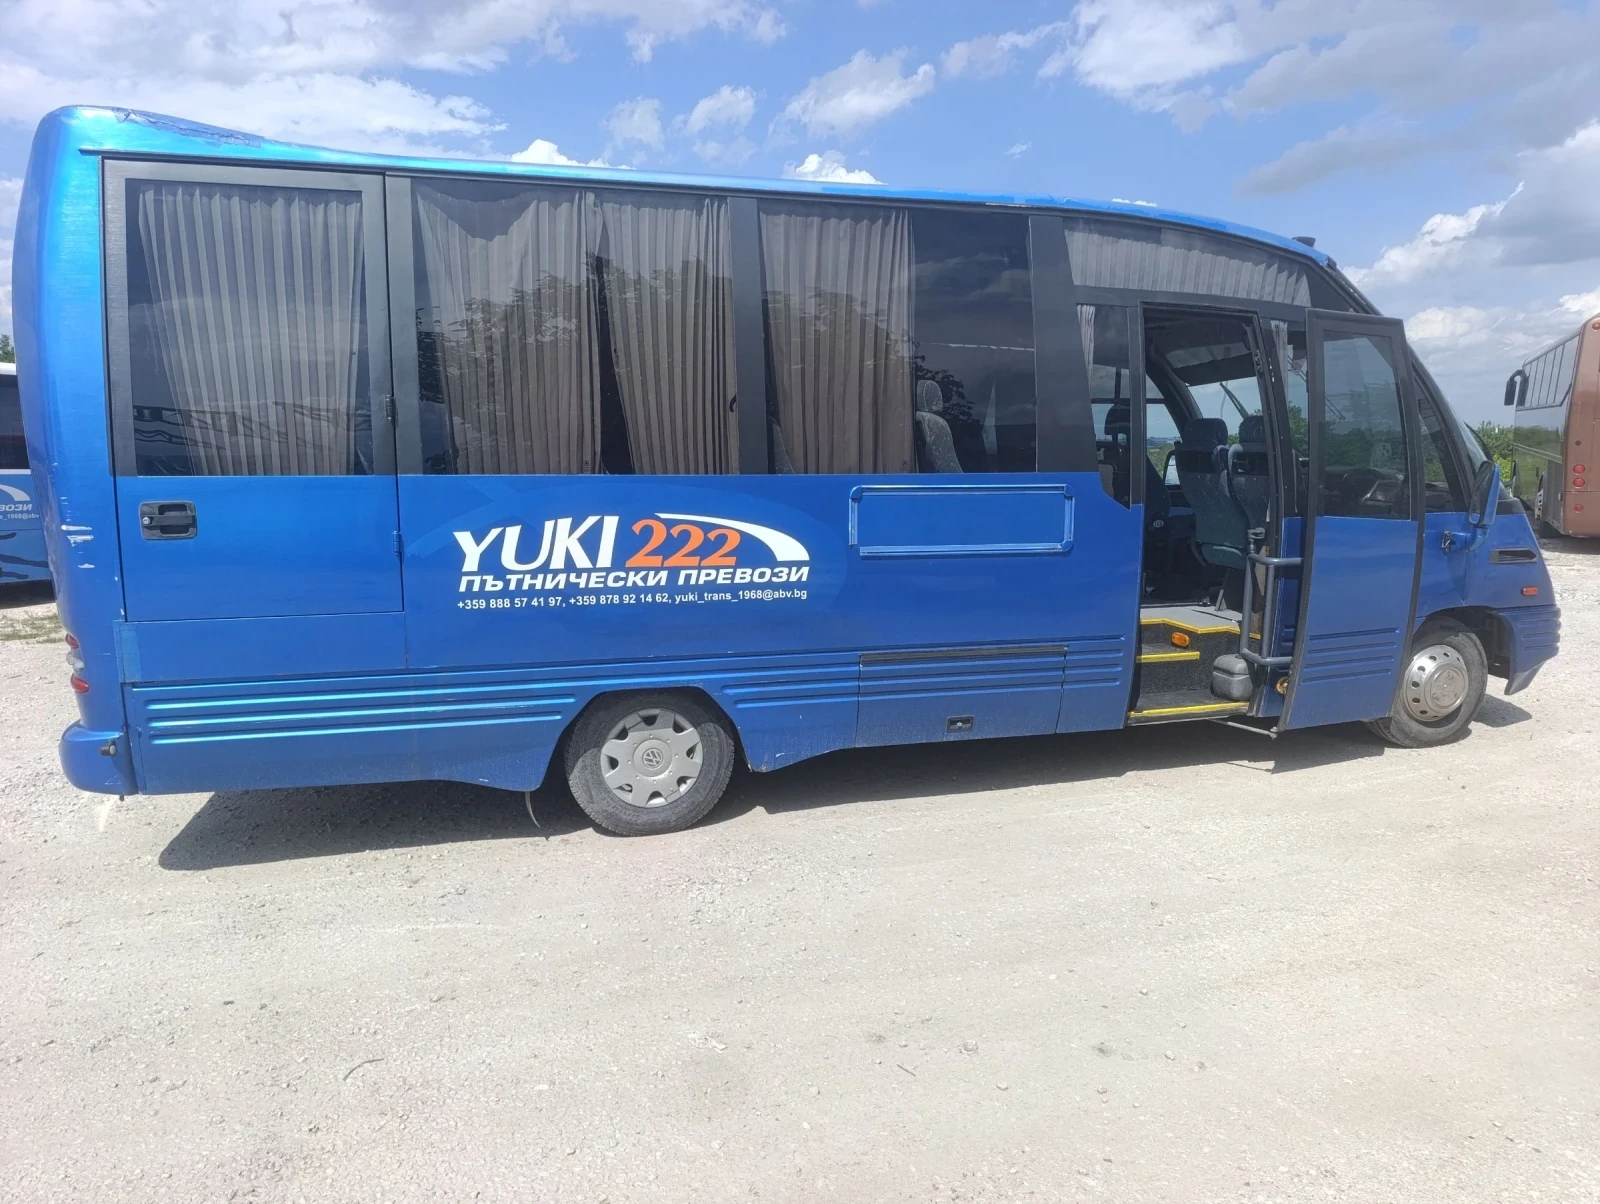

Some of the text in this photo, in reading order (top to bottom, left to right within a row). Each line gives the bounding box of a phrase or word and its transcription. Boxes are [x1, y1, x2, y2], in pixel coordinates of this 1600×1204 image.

[453, 515, 742, 572] YUKI 222
[458, 566, 810, 592] ПЪТНИЧЕСКИ ПРЕВОЗИ
[457, 589, 808, 609] +359 888 57 41 97, +359 878 92 14 62, yuki_trans_1968@abv.bg
